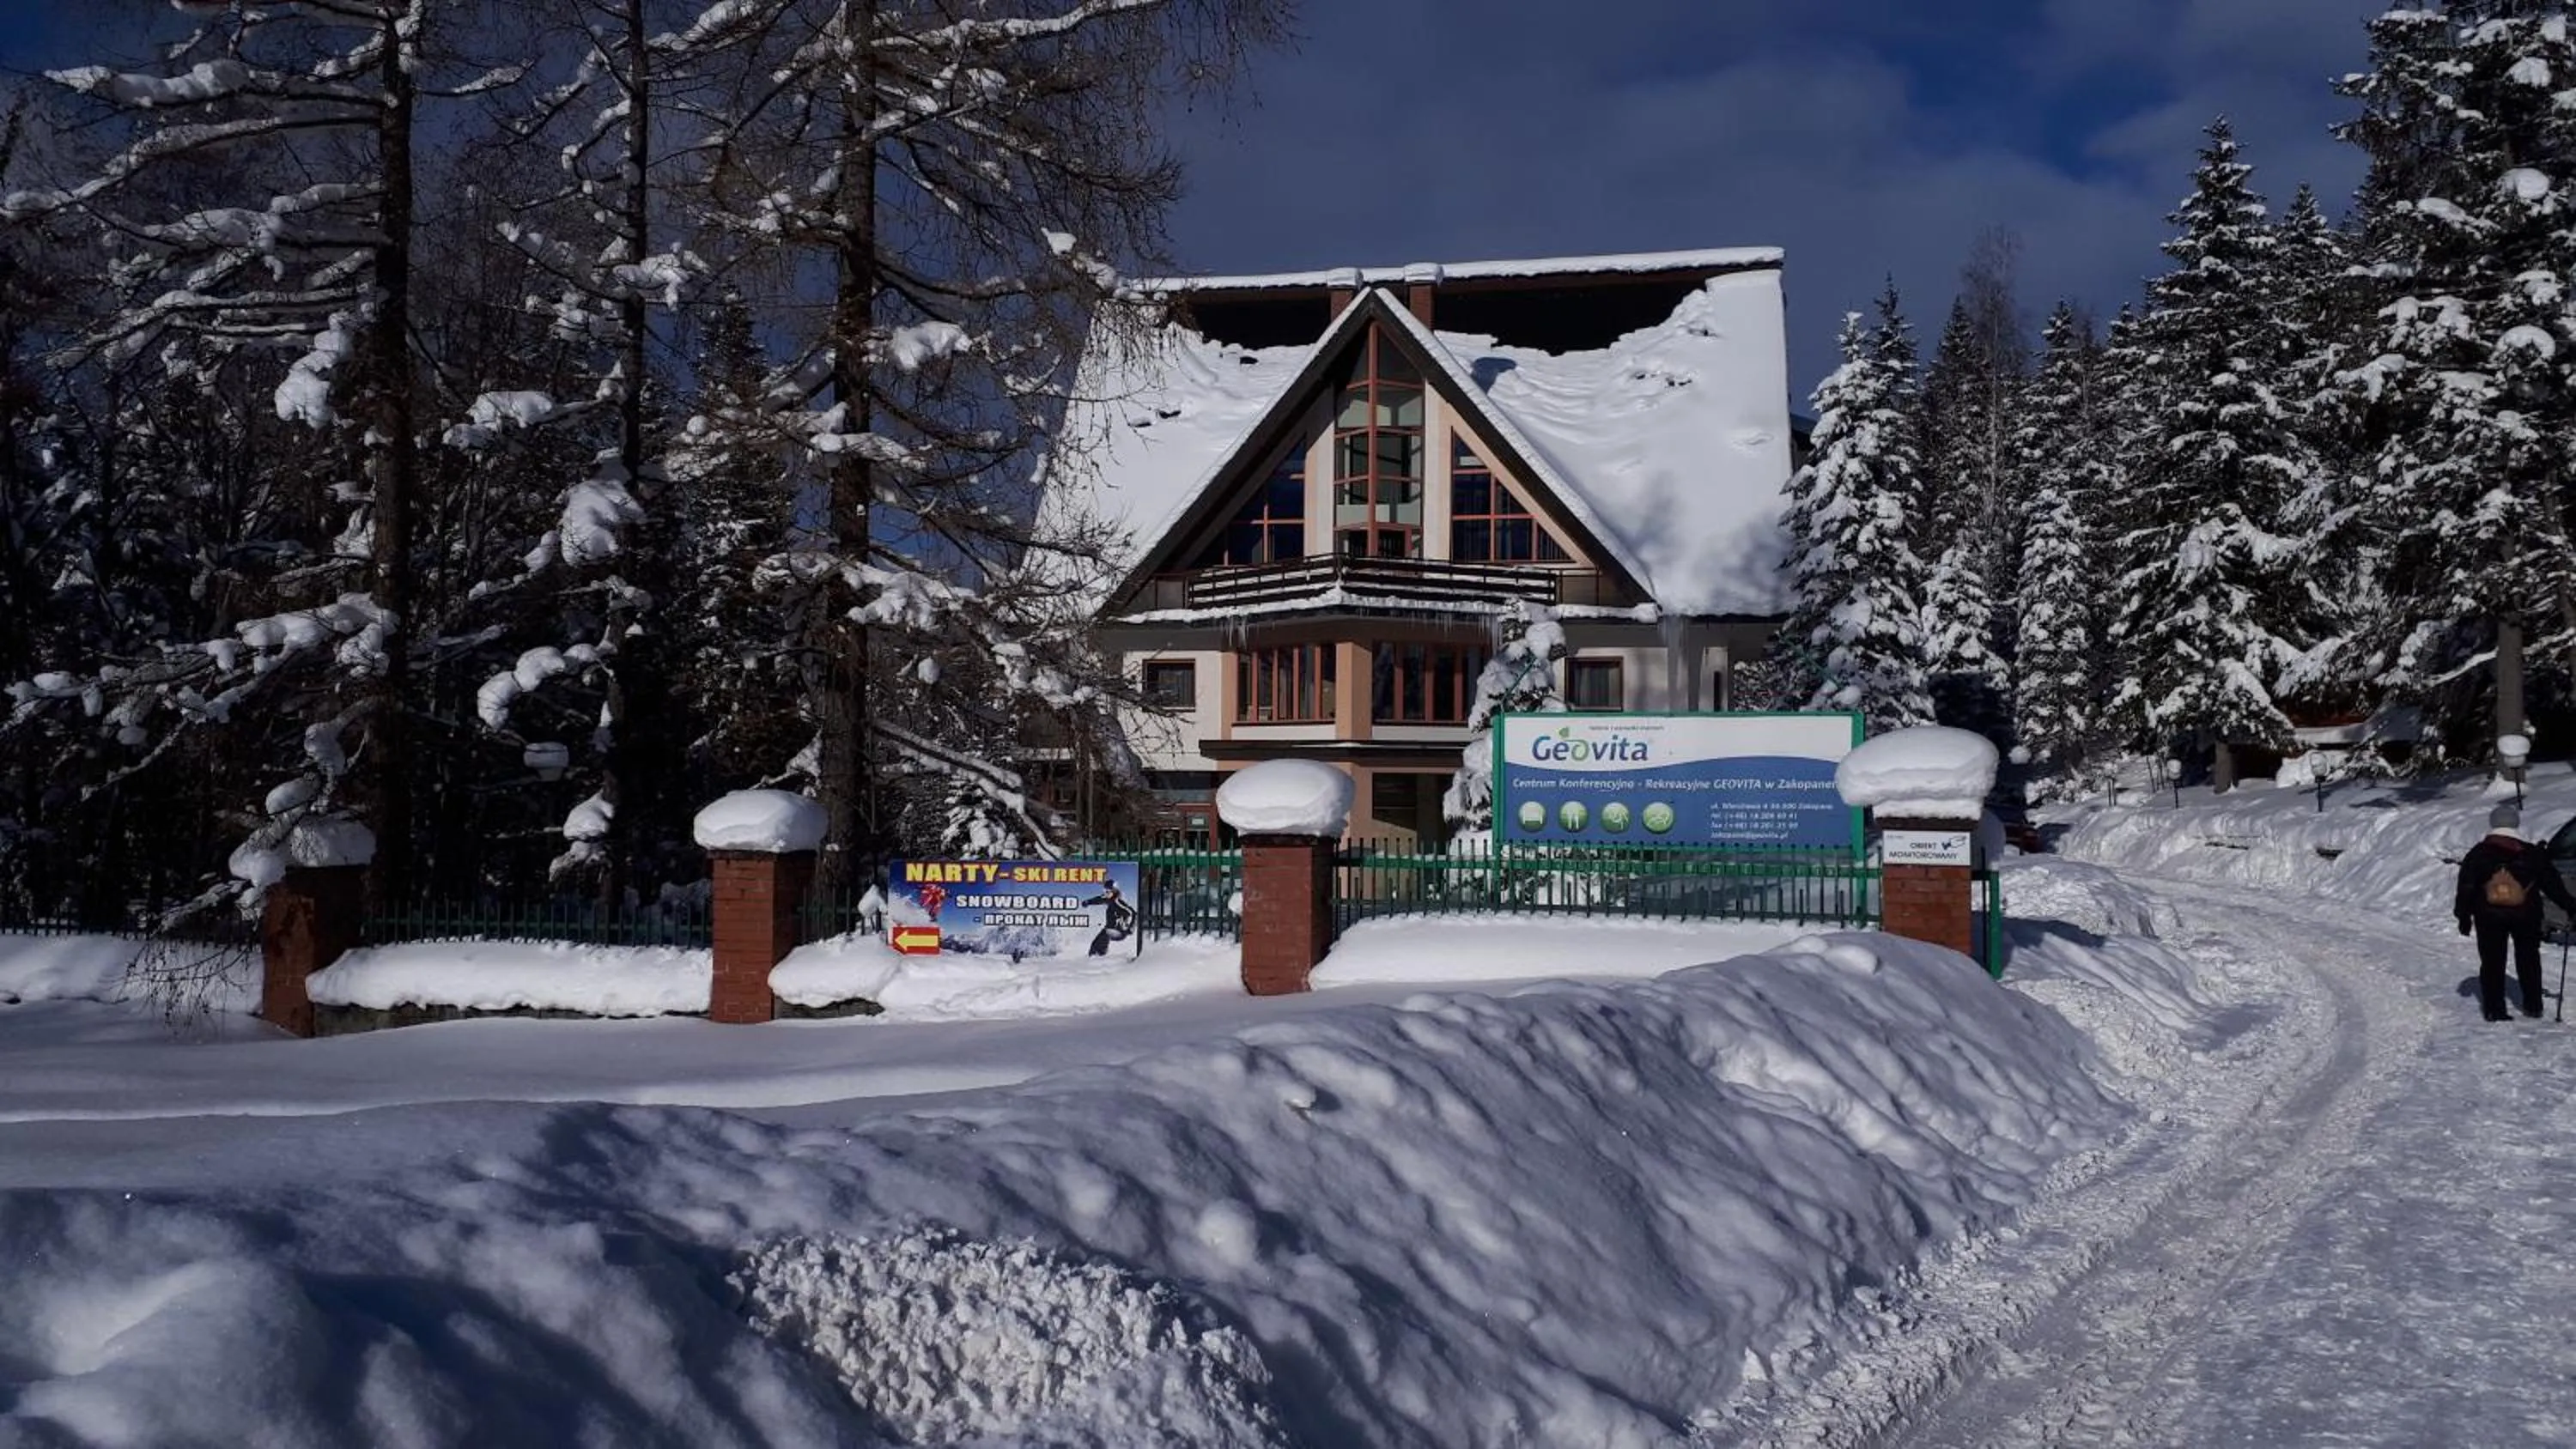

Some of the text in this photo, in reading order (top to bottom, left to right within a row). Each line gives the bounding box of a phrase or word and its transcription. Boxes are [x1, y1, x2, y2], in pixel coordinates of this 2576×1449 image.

[1532, 733, 1649, 761] Geovita
[1512, 777, 1556, 788] Centrum
[1558, 777, 1634, 791] Konferencyjno
[1645, 778, 1710, 792] Rekreacyjne
[1713, 778, 1761, 789] GEOVITA
[1765, 780, 1773, 789] w
[1012, 868, 1048, 882] SKI
[1053, 868, 1107, 882] RENT
[956, 894, 1078, 910] SNOWBOARD
[984, 913, 1045, 926] ПРОКАТ
[1046, 913, 1089, 927] ЛЫЖ
